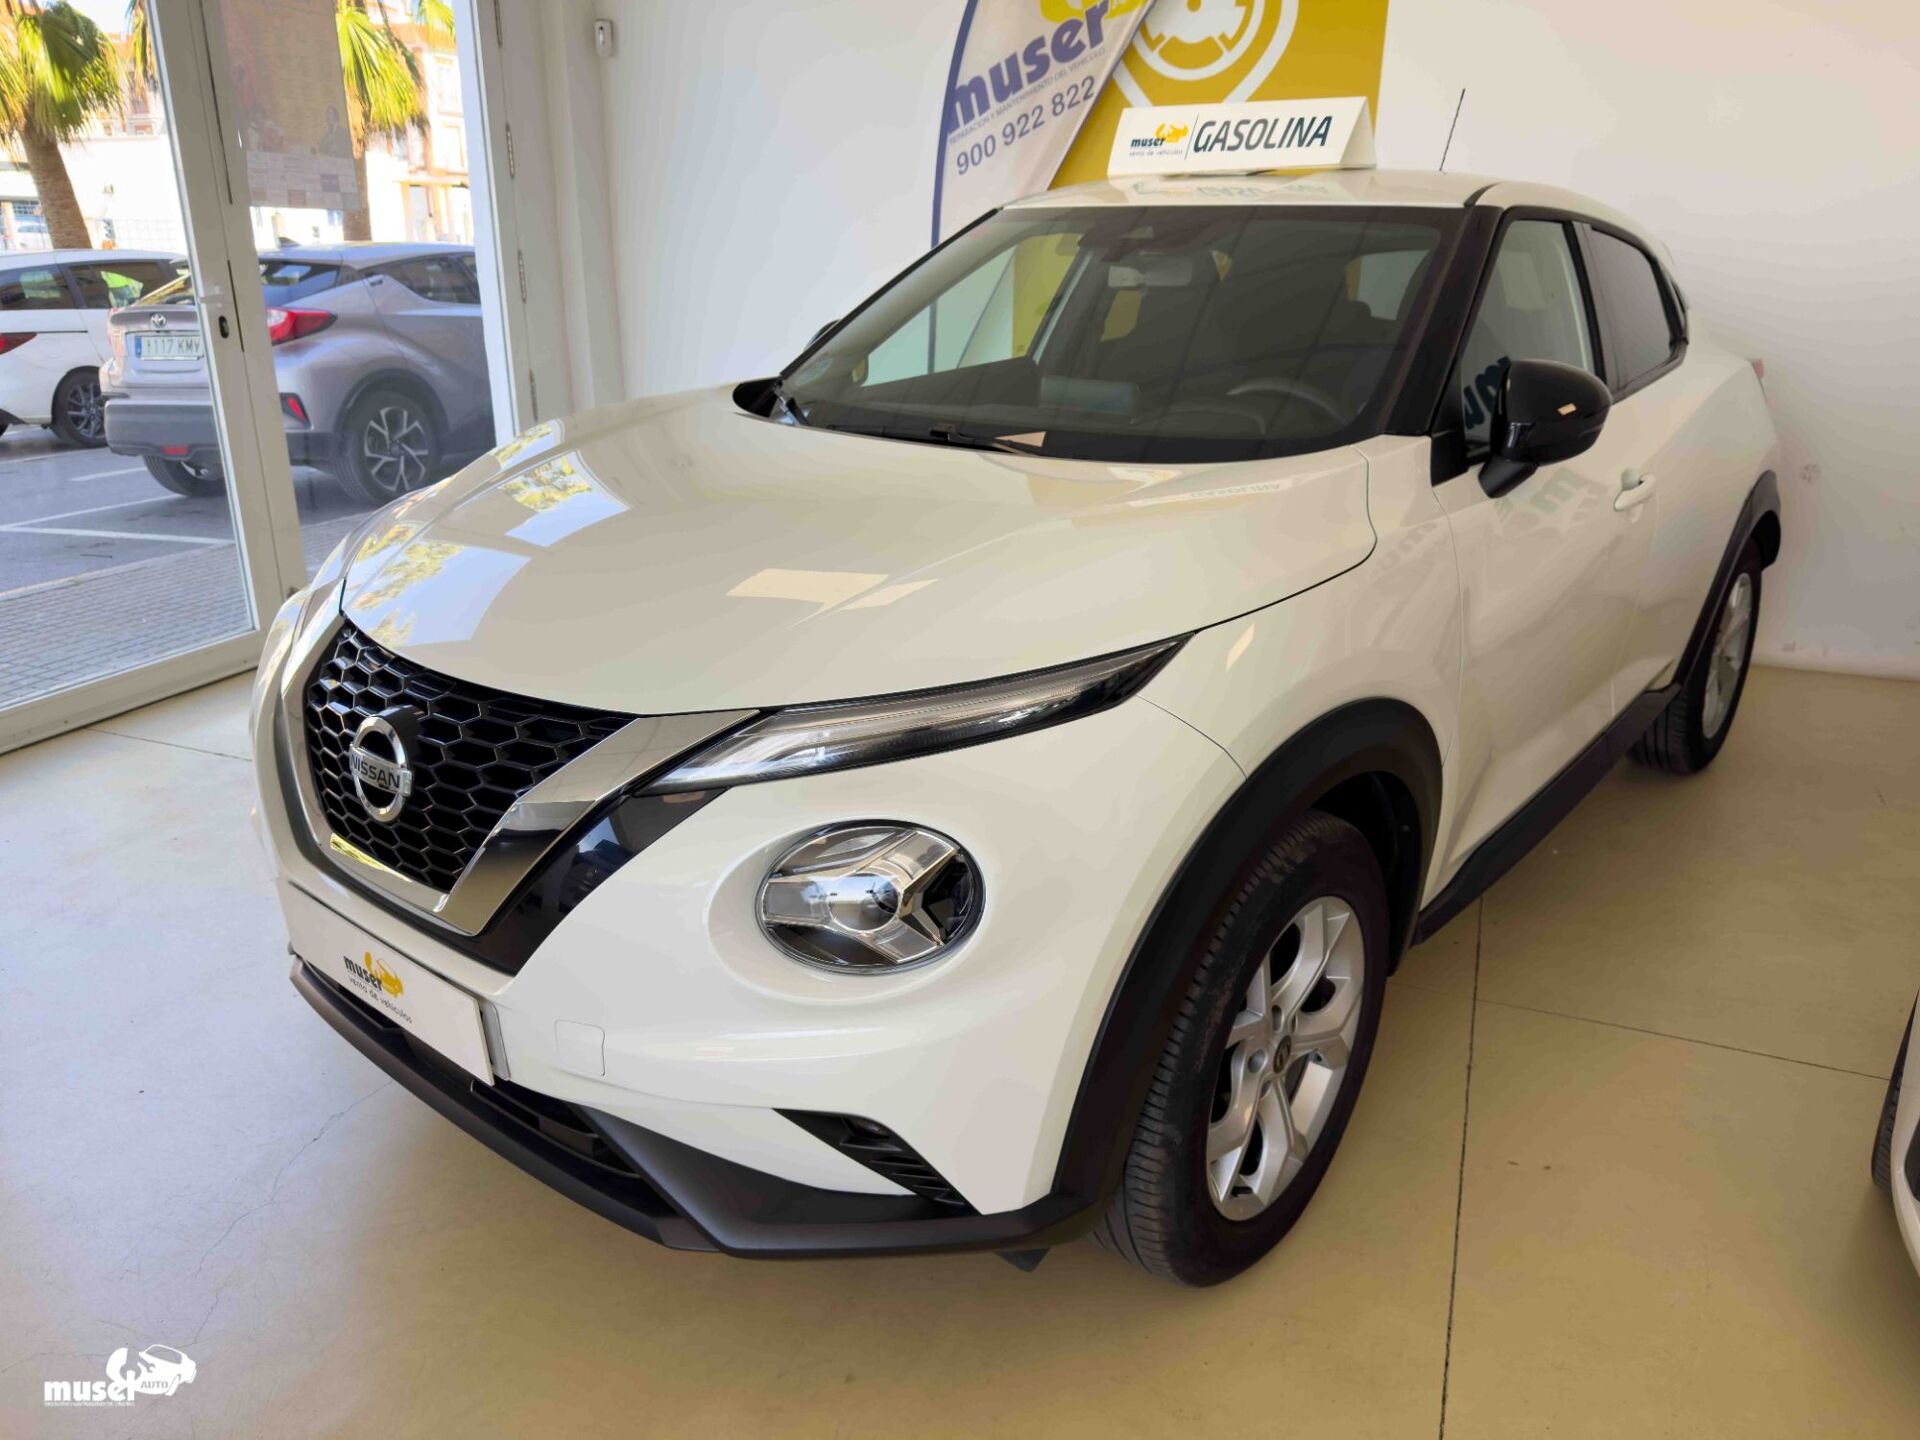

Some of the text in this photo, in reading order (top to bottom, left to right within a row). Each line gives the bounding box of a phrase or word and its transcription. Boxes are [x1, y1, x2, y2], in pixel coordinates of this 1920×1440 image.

[948, 0, 1109, 135] muser
[956, 75, 1096, 175] 900 922 822
[1130, 137, 1166, 148] muser
[1193, 115, 1333, 153] GASOLINA
[350, 754, 401, 789] NISSAN
[343, 955, 383, 992] muser
